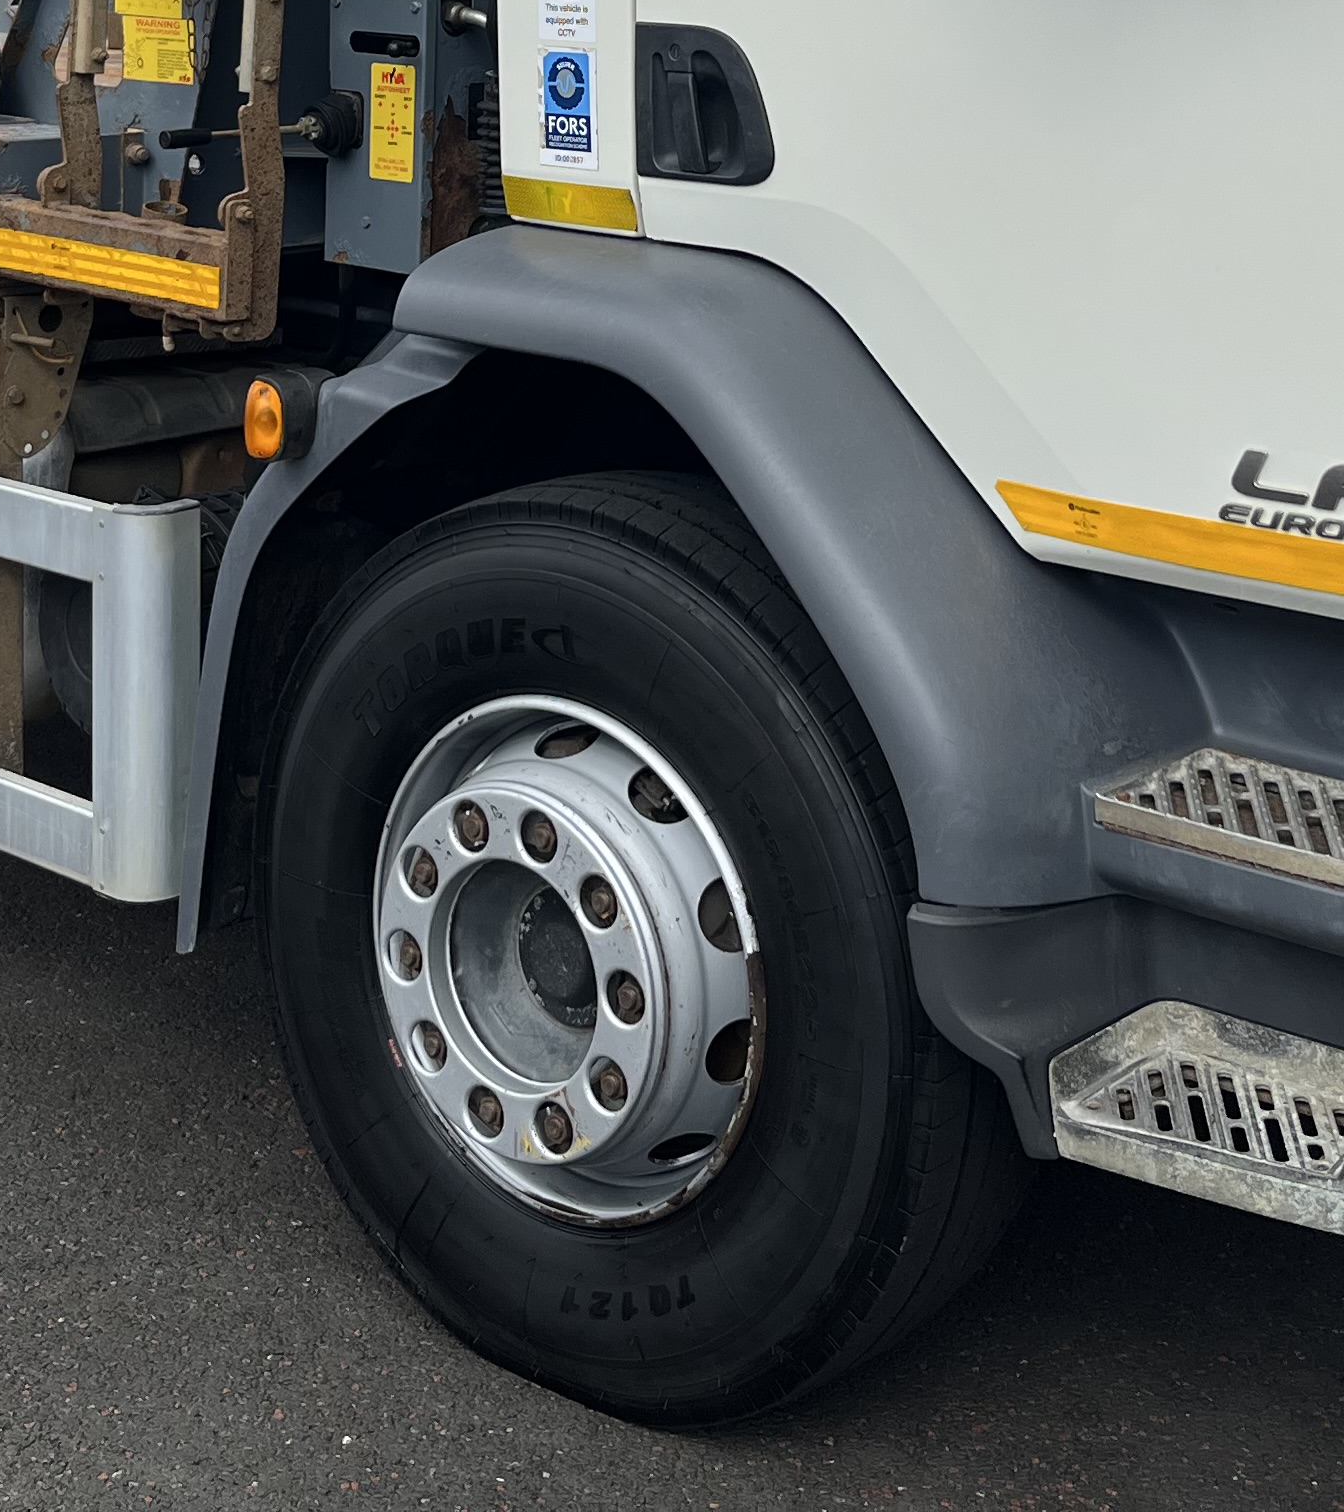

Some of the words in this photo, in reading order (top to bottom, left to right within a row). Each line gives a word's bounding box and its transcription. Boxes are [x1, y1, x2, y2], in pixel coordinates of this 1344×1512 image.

[545, 3, 559, 12] This
[559, 4, 582, 13] vehicle
[582, 5, 589, 13] is
[135, 18, 181, 30] WARNING
[545, 17, 575, 26] equipped
[575, 18, 589, 26] with
[557, 28, 576, 37] CCTV
[381, 67, 406, 86] HYVA
[547, 115, 587, 136] FORS
